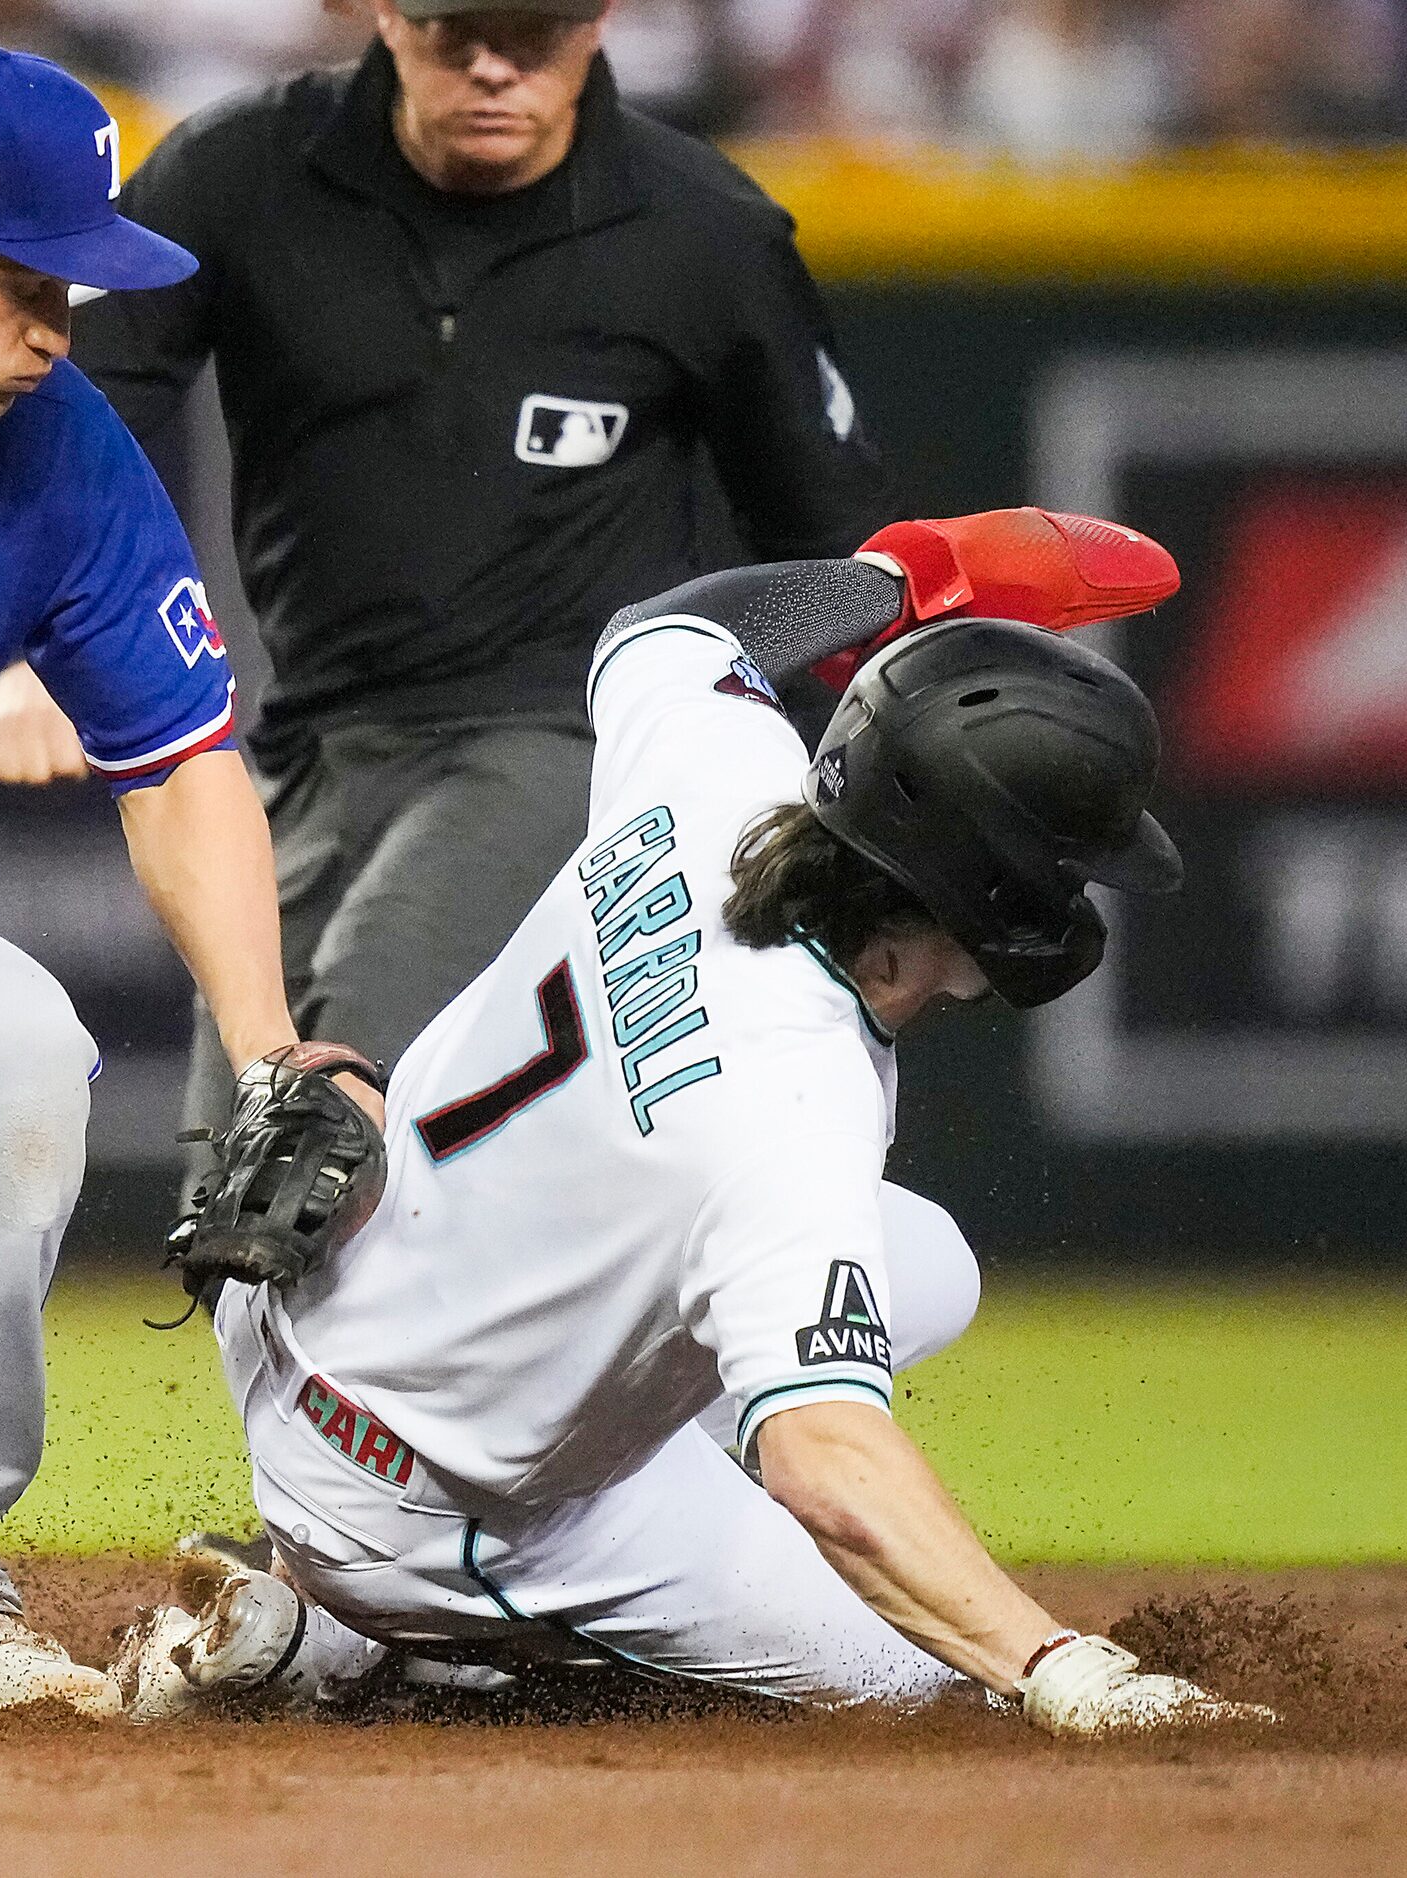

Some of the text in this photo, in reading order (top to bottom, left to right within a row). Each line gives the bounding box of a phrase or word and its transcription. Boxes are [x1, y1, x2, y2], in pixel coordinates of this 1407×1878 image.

[94, 117, 121, 200] T
[410, 950, 594, 1169] 7
[577, 805, 723, 1138] CARROLL
